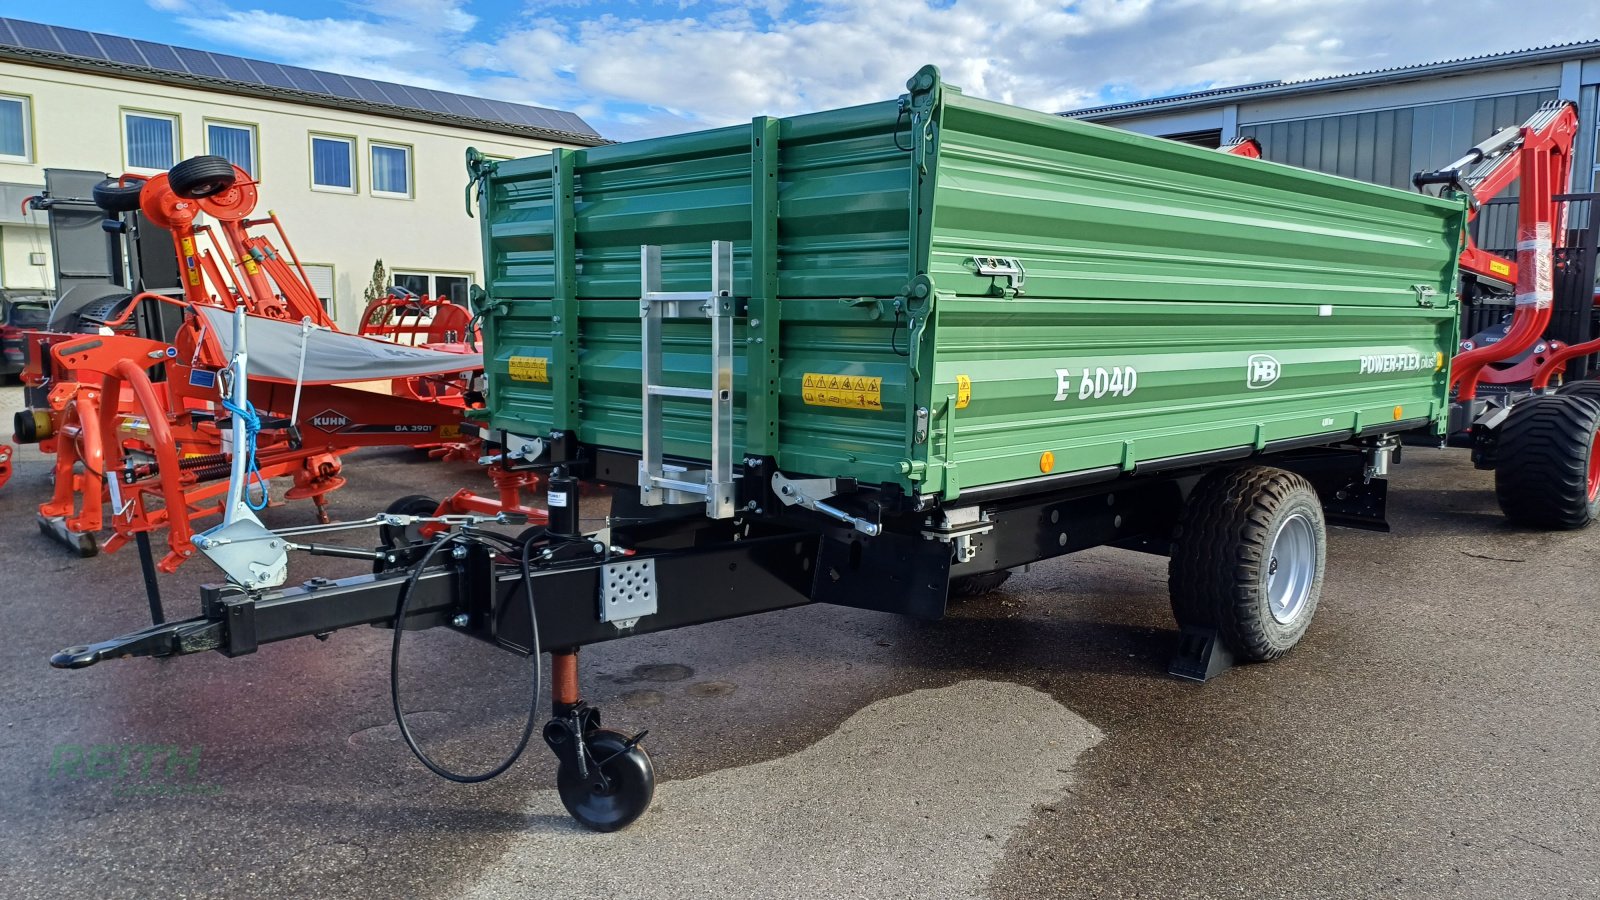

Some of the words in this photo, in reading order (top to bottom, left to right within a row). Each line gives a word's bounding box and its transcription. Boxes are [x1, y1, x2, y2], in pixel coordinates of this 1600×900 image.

[1359, 353, 1420, 374] POWER-FLEX
[1053, 368, 1070, 401] E
[1078, 366, 1138, 400] 6040
[313, 417, 346, 426] KUHN
